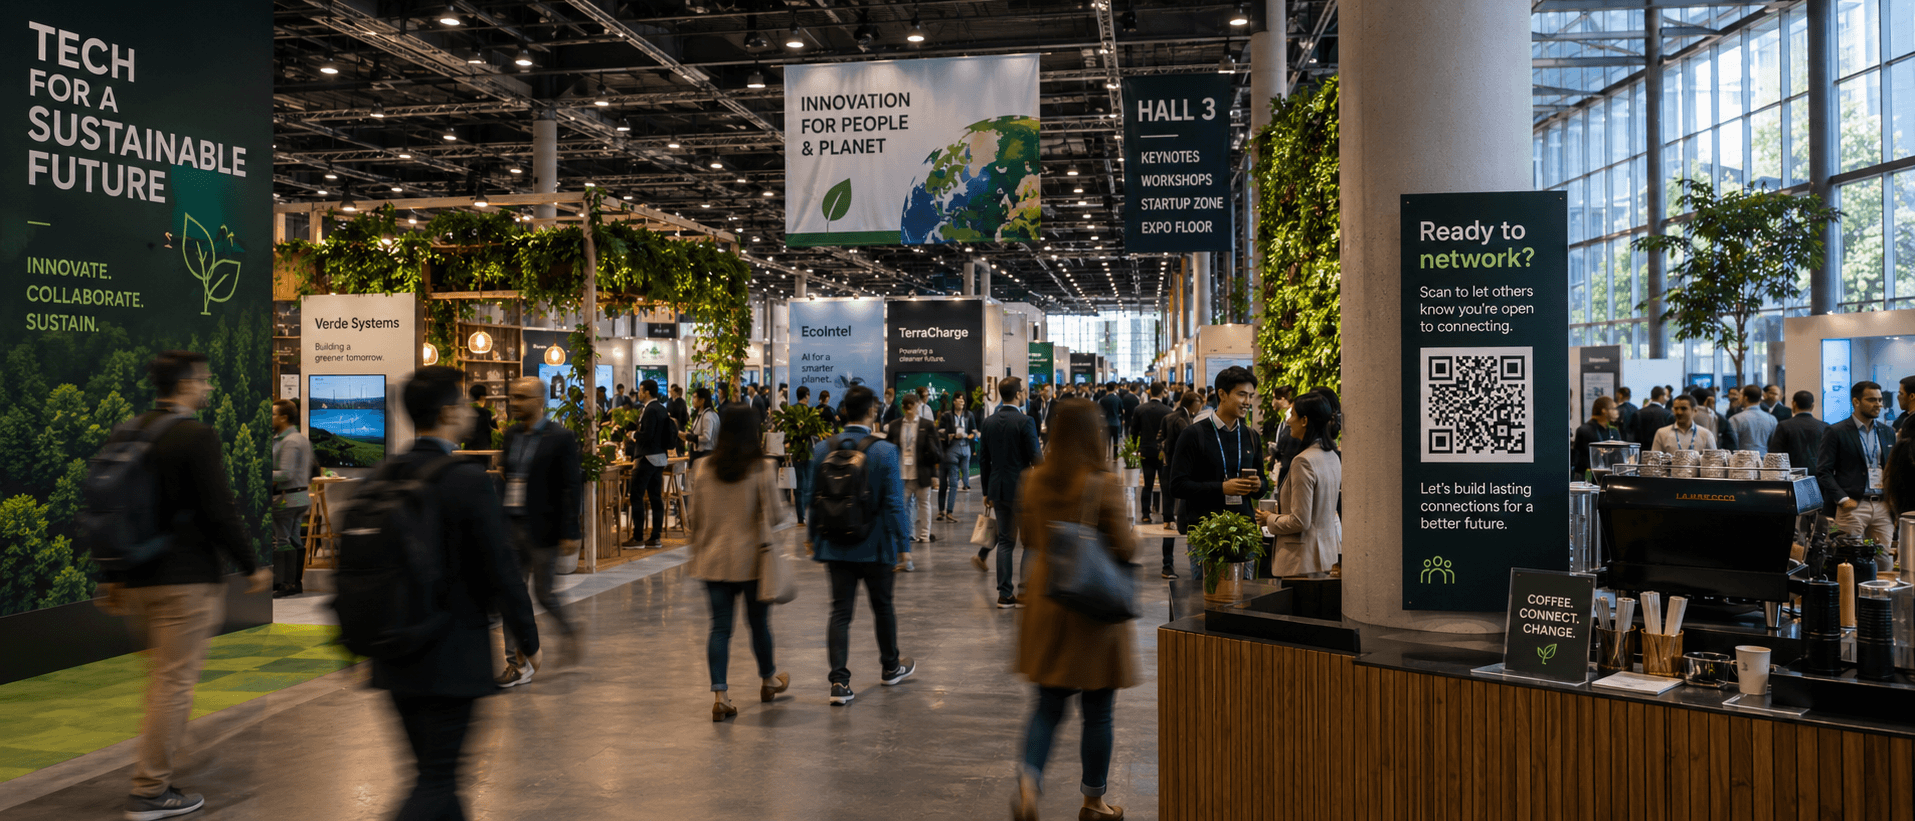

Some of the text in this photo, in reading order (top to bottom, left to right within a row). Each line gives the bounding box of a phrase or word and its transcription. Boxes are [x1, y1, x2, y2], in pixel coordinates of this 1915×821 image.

[28, 20, 136, 83] TECH
[29, 68, 118, 113] FOR A
[802, 92, 910, 111] INNOVATION
[1138, 98, 1215, 121] HALL 3
[802, 115, 908, 134] FOR PEOPLE
[28, 105, 247, 178] SUSTAINABLE
[802, 138, 886, 156] & PLANET
[1142, 150, 1199, 163] KEYNOTES
[28, 149, 167, 203] FUTURE
[1141, 173, 1212, 186] WORKSHOPS
[1142, 197, 1223, 210] STARTUP ZONE
[1142, 221, 1212, 233] EXPO FLOOR
[1421, 220, 1525, 245] Ready to
[1421, 247, 1534, 268] network?
[28, 257, 111, 279] INNOVATE.
[27, 285, 143, 307] COLLABORATE.
[1420, 285, 1533, 298] Scan to let others
[1421, 303, 1533, 317] know you're open
[26, 313, 99, 332] SUSTAIN.
[315, 317, 399, 331] Verde Systems
[1420, 320, 1512, 334] to connecting.
[802, 326, 851, 337] EcoIntel
[899, 327, 968, 340] TerraCharge
[315, 354, 384, 364] greener tomorrow.
[802, 353, 811, 361] AI
[812, 353, 824, 361] for
[924, 354, 946, 362] future.
[802, 364, 834, 373] smarter
[802, 375, 832, 385] planet.
[1421, 483, 1531, 497] Let's build lasting
[1421, 500, 1533, 512] connections for a
[1421, 517, 1507, 529] better future.
[1527, 594, 1574, 609] COFFEE.
[1519, 608, 1580, 625] CONNECT.
[1522, 623, 1577, 639] CHANGE.
